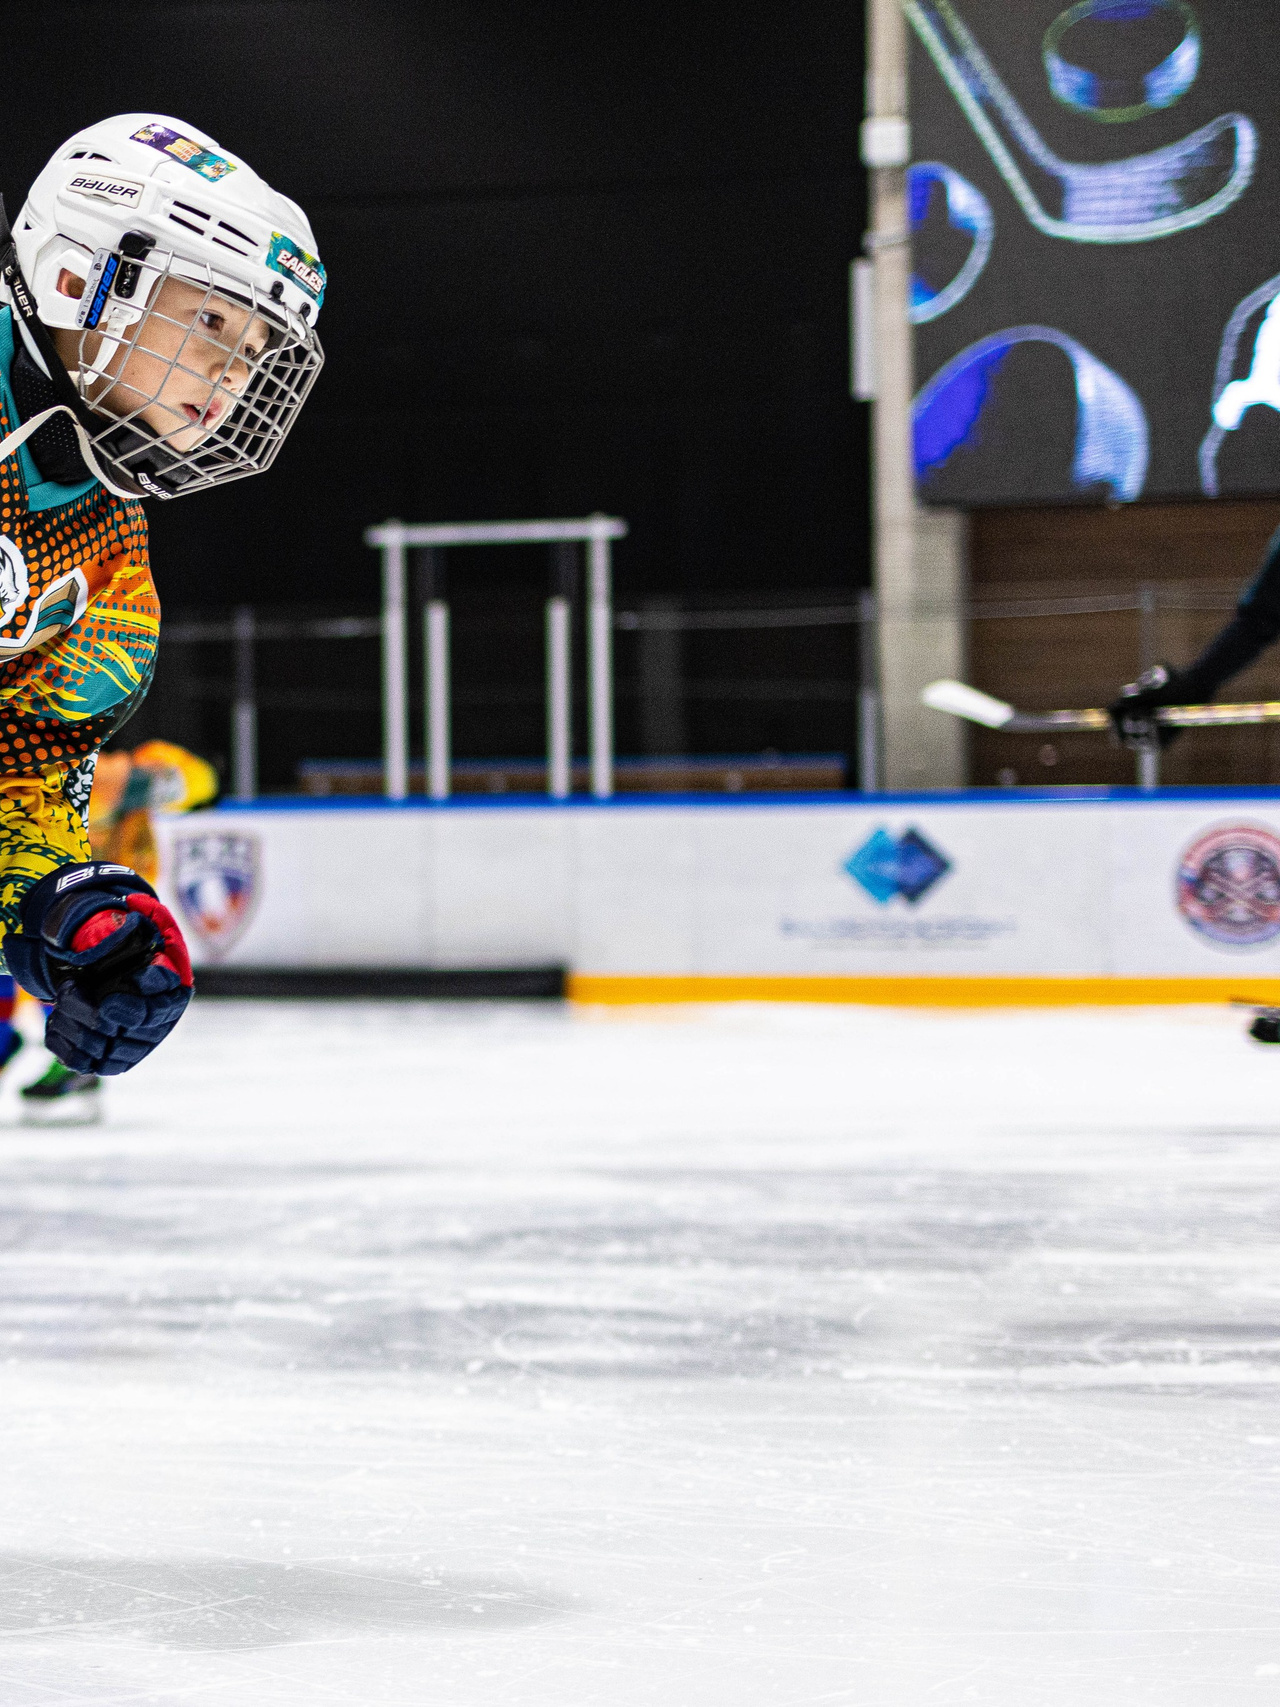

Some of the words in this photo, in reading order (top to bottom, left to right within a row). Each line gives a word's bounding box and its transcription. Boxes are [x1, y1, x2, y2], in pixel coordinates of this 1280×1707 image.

[69, 177, 139, 199] BAUER
[276, 248, 323, 293] EAGLES
[88, 257, 118, 326] BAUER
[137, 472, 173, 500] BAUE
